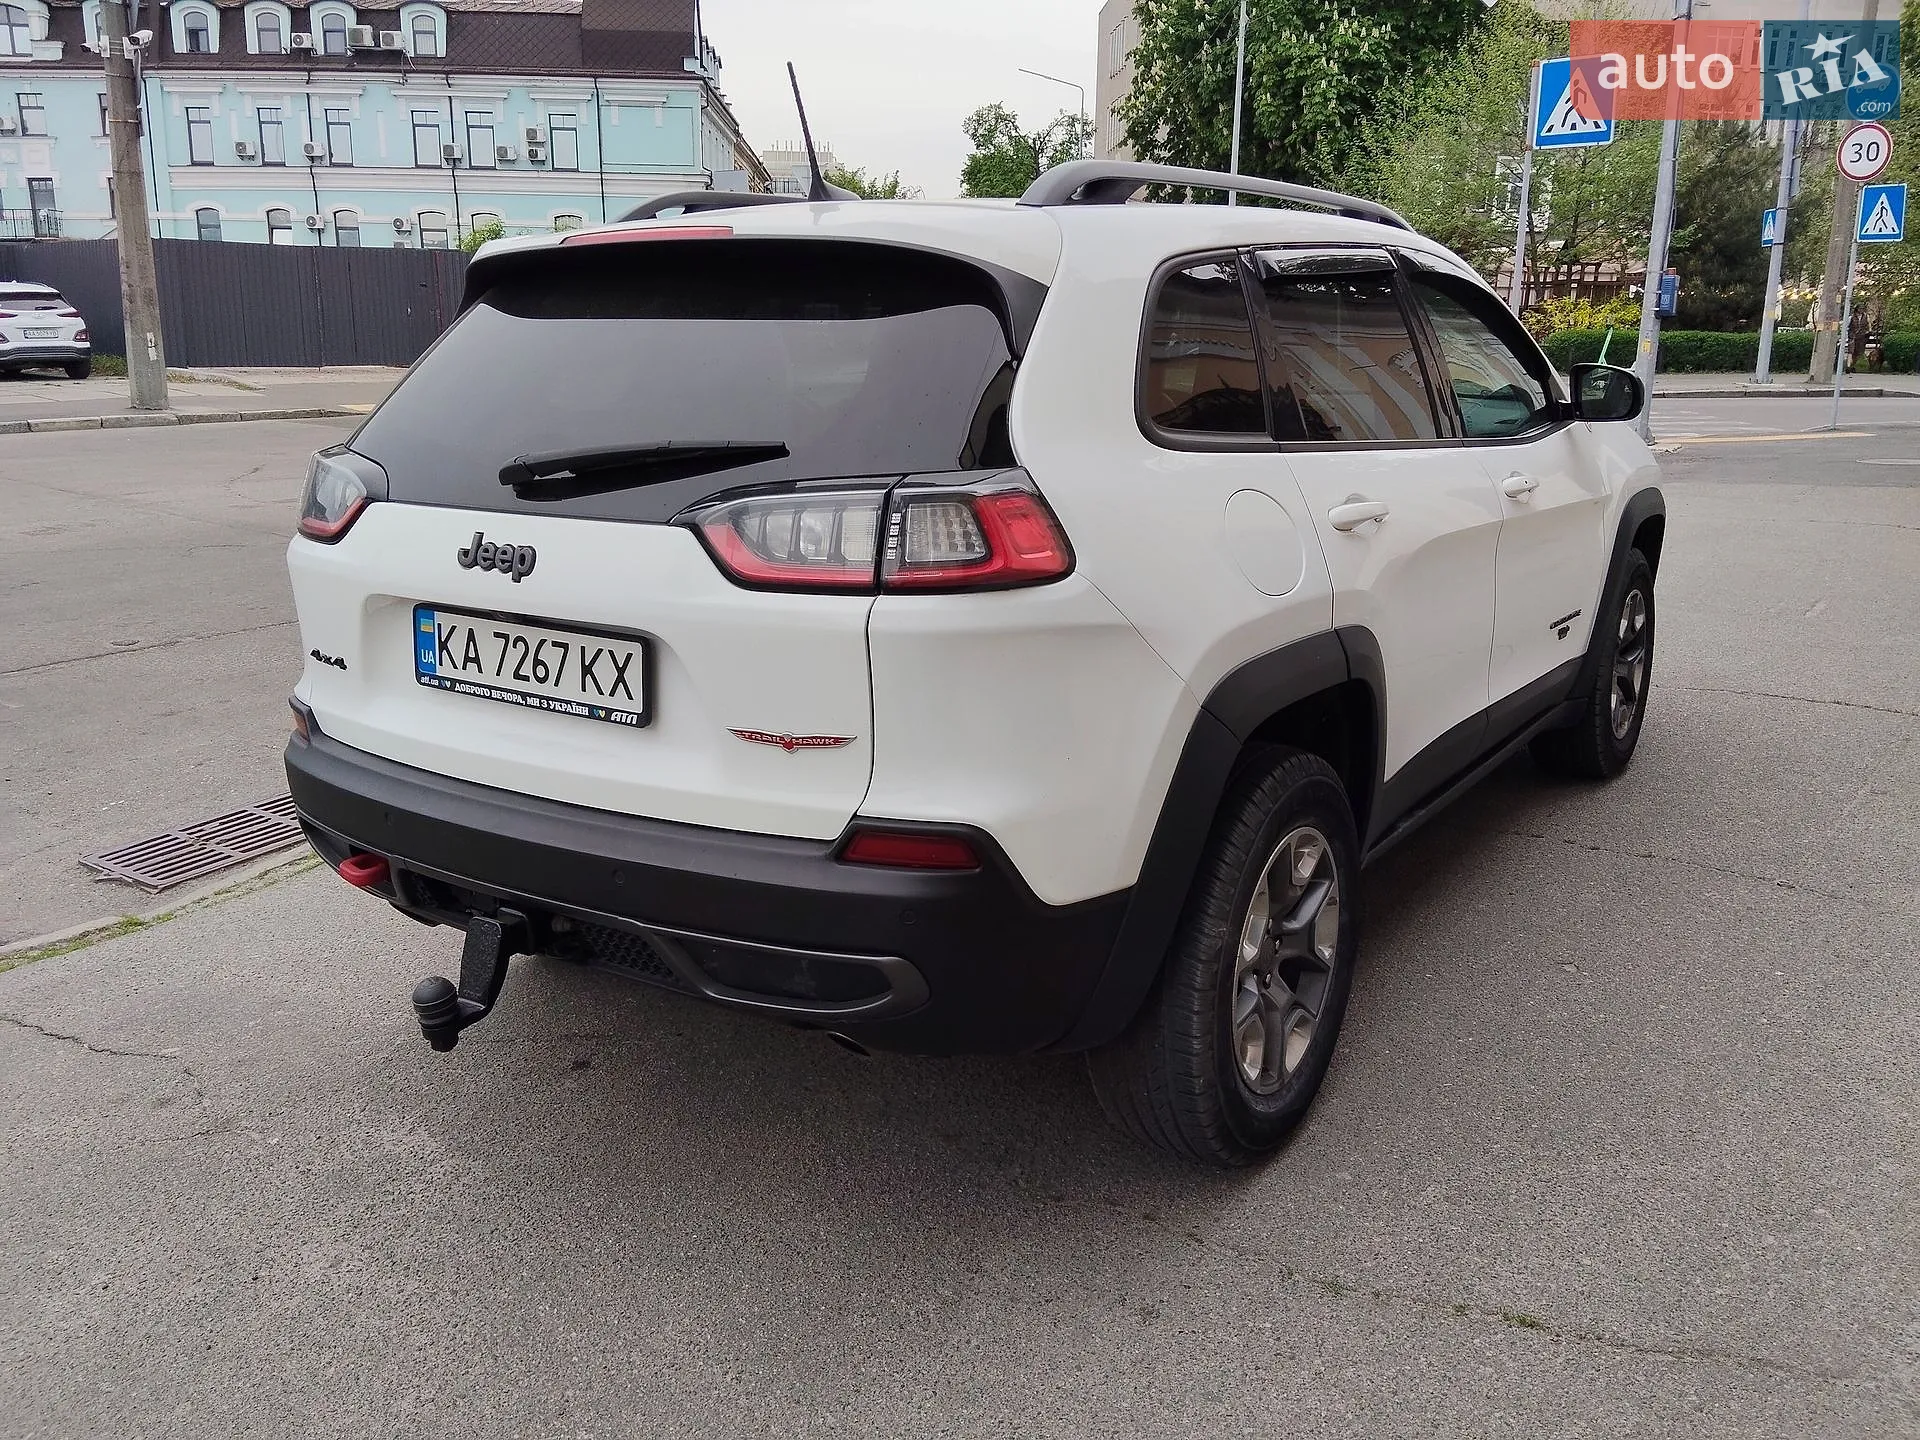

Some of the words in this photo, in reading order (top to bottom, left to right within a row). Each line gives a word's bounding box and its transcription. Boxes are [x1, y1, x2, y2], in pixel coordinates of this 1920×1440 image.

[1849, 141, 1880, 163] 30
[457, 531, 537, 583] Jeep
[421, 649, 435, 665] UA
[437, 622, 483, 674] KA
[492, 631, 570, 687] 7267
[580, 645, 634, 701] KX
[454, 682, 491, 697] ДОБРОГО
[548, 700, 590, 716] УКРАЇНИ
